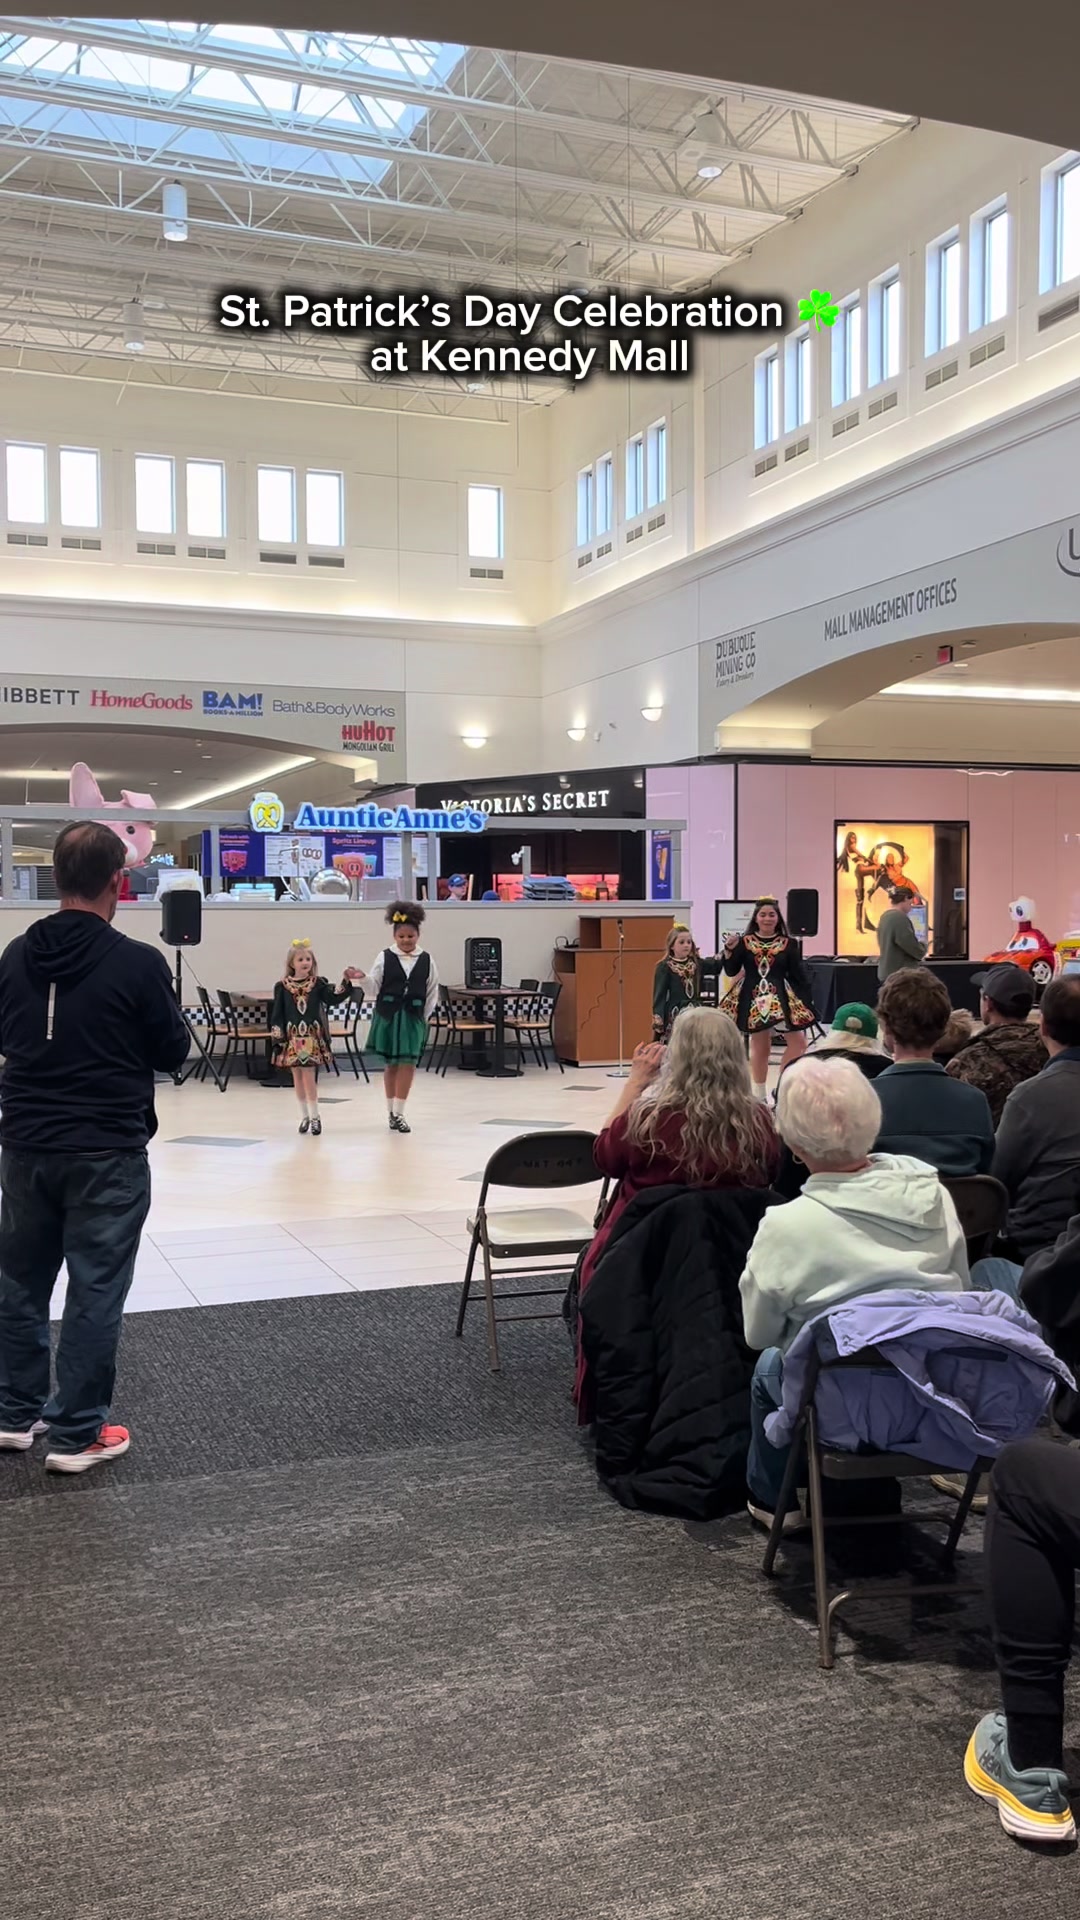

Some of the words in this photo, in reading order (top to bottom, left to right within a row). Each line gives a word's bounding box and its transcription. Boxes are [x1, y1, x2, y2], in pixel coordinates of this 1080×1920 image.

[824, 614, 848, 641] MALL
[849, 591, 915, 633] MANAGEMENT
[916, 578, 957, 613] OFFICES
[716, 631, 756, 660] DUBUQUE
[715, 655, 743, 678] MINING
[745, 651, 756, 669] CO
[0, 686, 80, 706] IBBETT
[90, 689, 193, 710] HomeGoods
[202, 690, 263, 710] BAM!
[542, 789, 609, 811] SECRET
[300, 804, 393, 828] Auntie
